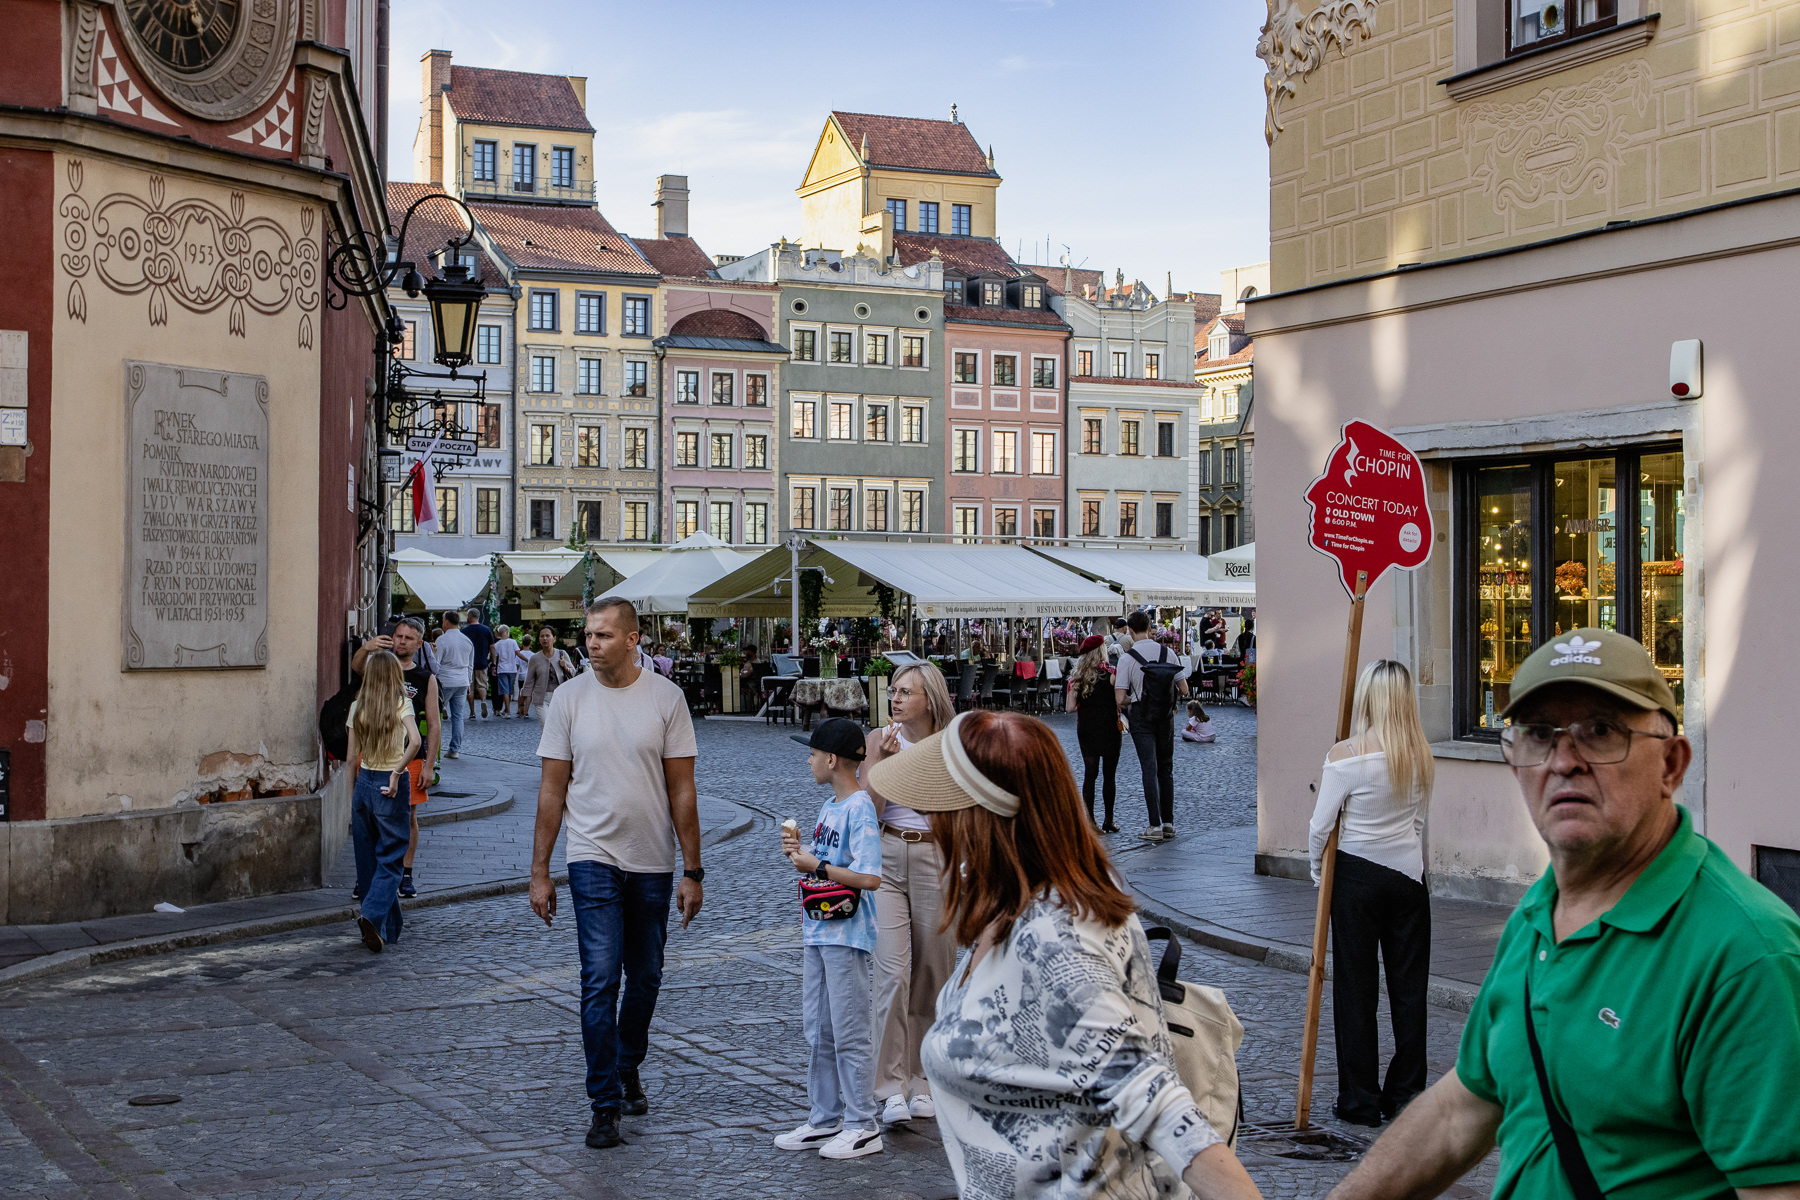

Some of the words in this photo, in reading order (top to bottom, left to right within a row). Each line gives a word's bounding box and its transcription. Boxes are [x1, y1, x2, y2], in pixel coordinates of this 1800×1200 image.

[185, 242, 214, 266] 1953
[154, 410, 197, 441] RYNEK
[176, 429, 222, 447] STAREGO
[224, 432, 259, 450] MIASTA
[440, 442, 473, 452] POCZTA
[143, 443, 182, 462] POMNIK
[1379, 449, 1396, 459] TIME
[1397, 452, 1411, 462] FOR
[200, 463, 257, 481] NARODOWEJ
[1356, 455, 1411, 480] CHOPIN
[147, 478, 175, 494] WALK
[185, 497, 257, 514] WARSZAWY
[1326, 491, 1379, 511] CONCERT
[1383, 500, 1418, 518] TODAY
[143, 511, 189, 527] ZWALONY
[190, 514, 199, 528] W
[231, 515, 257, 531] PRZEZ
[1332, 508, 1349, 518] OLD
[1350, 511, 1375, 523] TOWN
[1332, 518, 1344, 527] 6:00
[1345, 520, 1358, 528] P.M.
[1564, 518, 1610, 534] AMBER
[143, 528, 210, 544] FASZYSTOWSKICH
[166, 545, 178, 560] W
[180, 545, 201, 561] 1944
[1350, 544, 1365, 552] Chopin
[176, 561, 210, 576] POLSKI
[1224, 562, 1251, 577] Kozel
[142, 576, 149, 590] Z
[142, 592, 146, 606] I
[147, 592, 197, 606] NARODOWI
[155, 607, 166, 621] W
[168, 607, 202, 621] LATACH
[1037, 605, 1076, 613] RESTAURACJA
[1078, 605, 1095, 613] STARA
[1096, 605, 1118, 613] POCZTA
[1550, 654, 1602, 666] adidas
[1056, 1059, 1077, 1080] We
[1072, 1027, 1097, 1057] love
[1072, 1073, 1088, 1090] to
